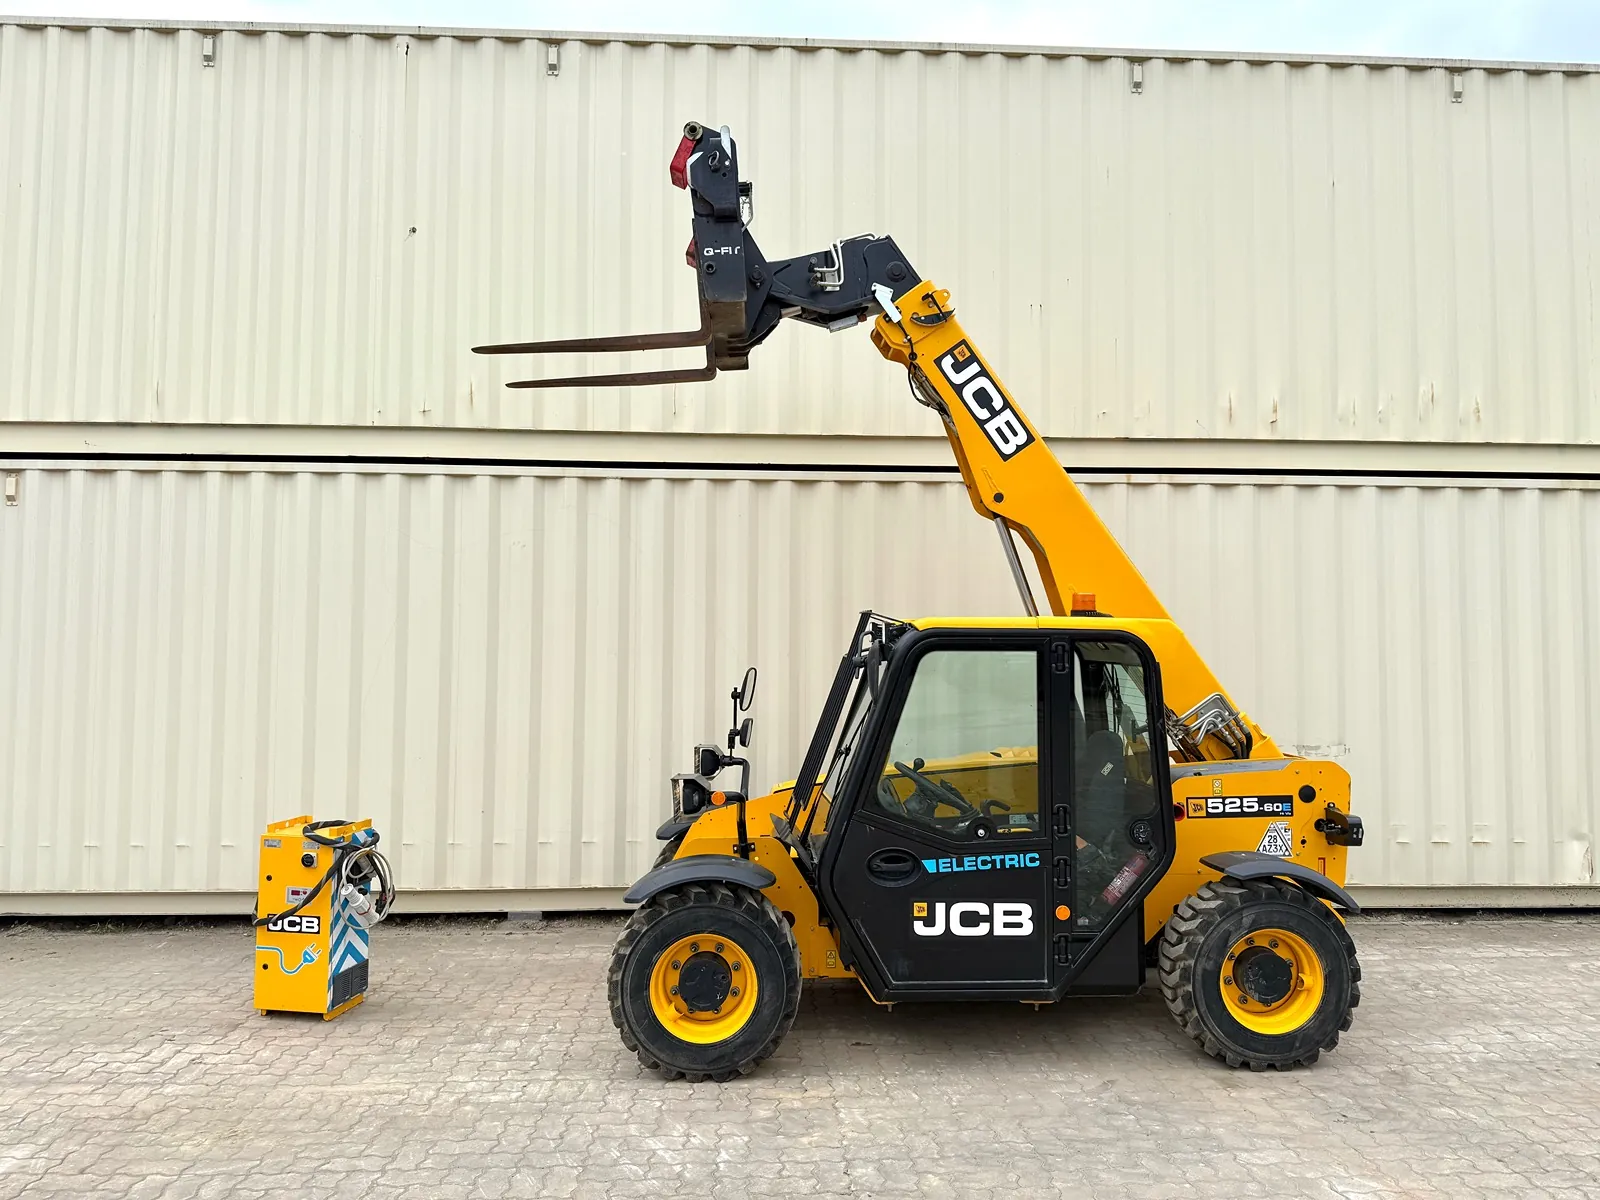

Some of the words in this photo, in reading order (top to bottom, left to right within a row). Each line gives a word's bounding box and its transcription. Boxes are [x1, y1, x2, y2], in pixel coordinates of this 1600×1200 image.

[941, 354, 1028, 455] JCB
[1207, 797, 1292, 813] 525-60E
[1267, 834, 1278, 844] 28
[1262, 844, 1284, 853] AZ3X
[938, 852, 1040, 873] ELECTRIC
[913, 902, 1034, 936] JCB
